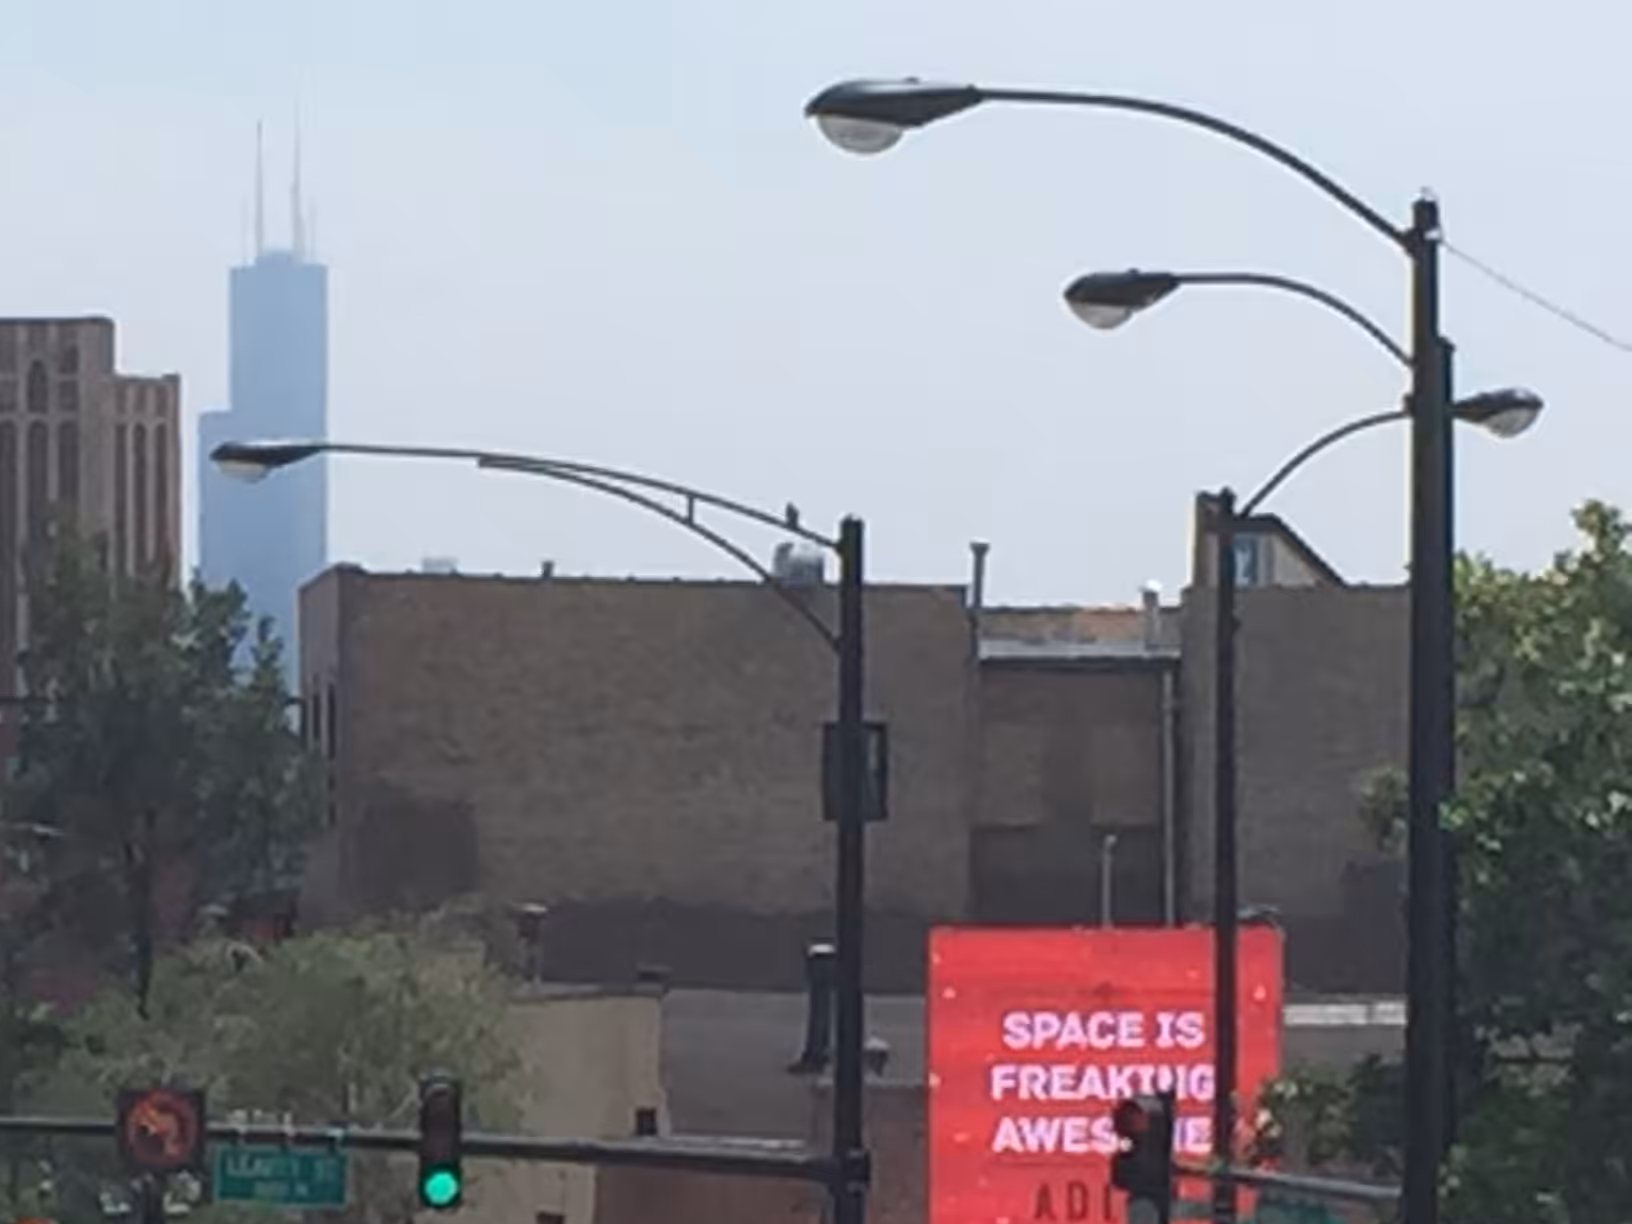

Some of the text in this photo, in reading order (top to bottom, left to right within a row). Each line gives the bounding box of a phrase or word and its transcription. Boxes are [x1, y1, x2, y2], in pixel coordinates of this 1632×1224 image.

[1001, 1010, 1206, 1050] SPACE IS
[991, 1116, 1214, 1156] AWESE
